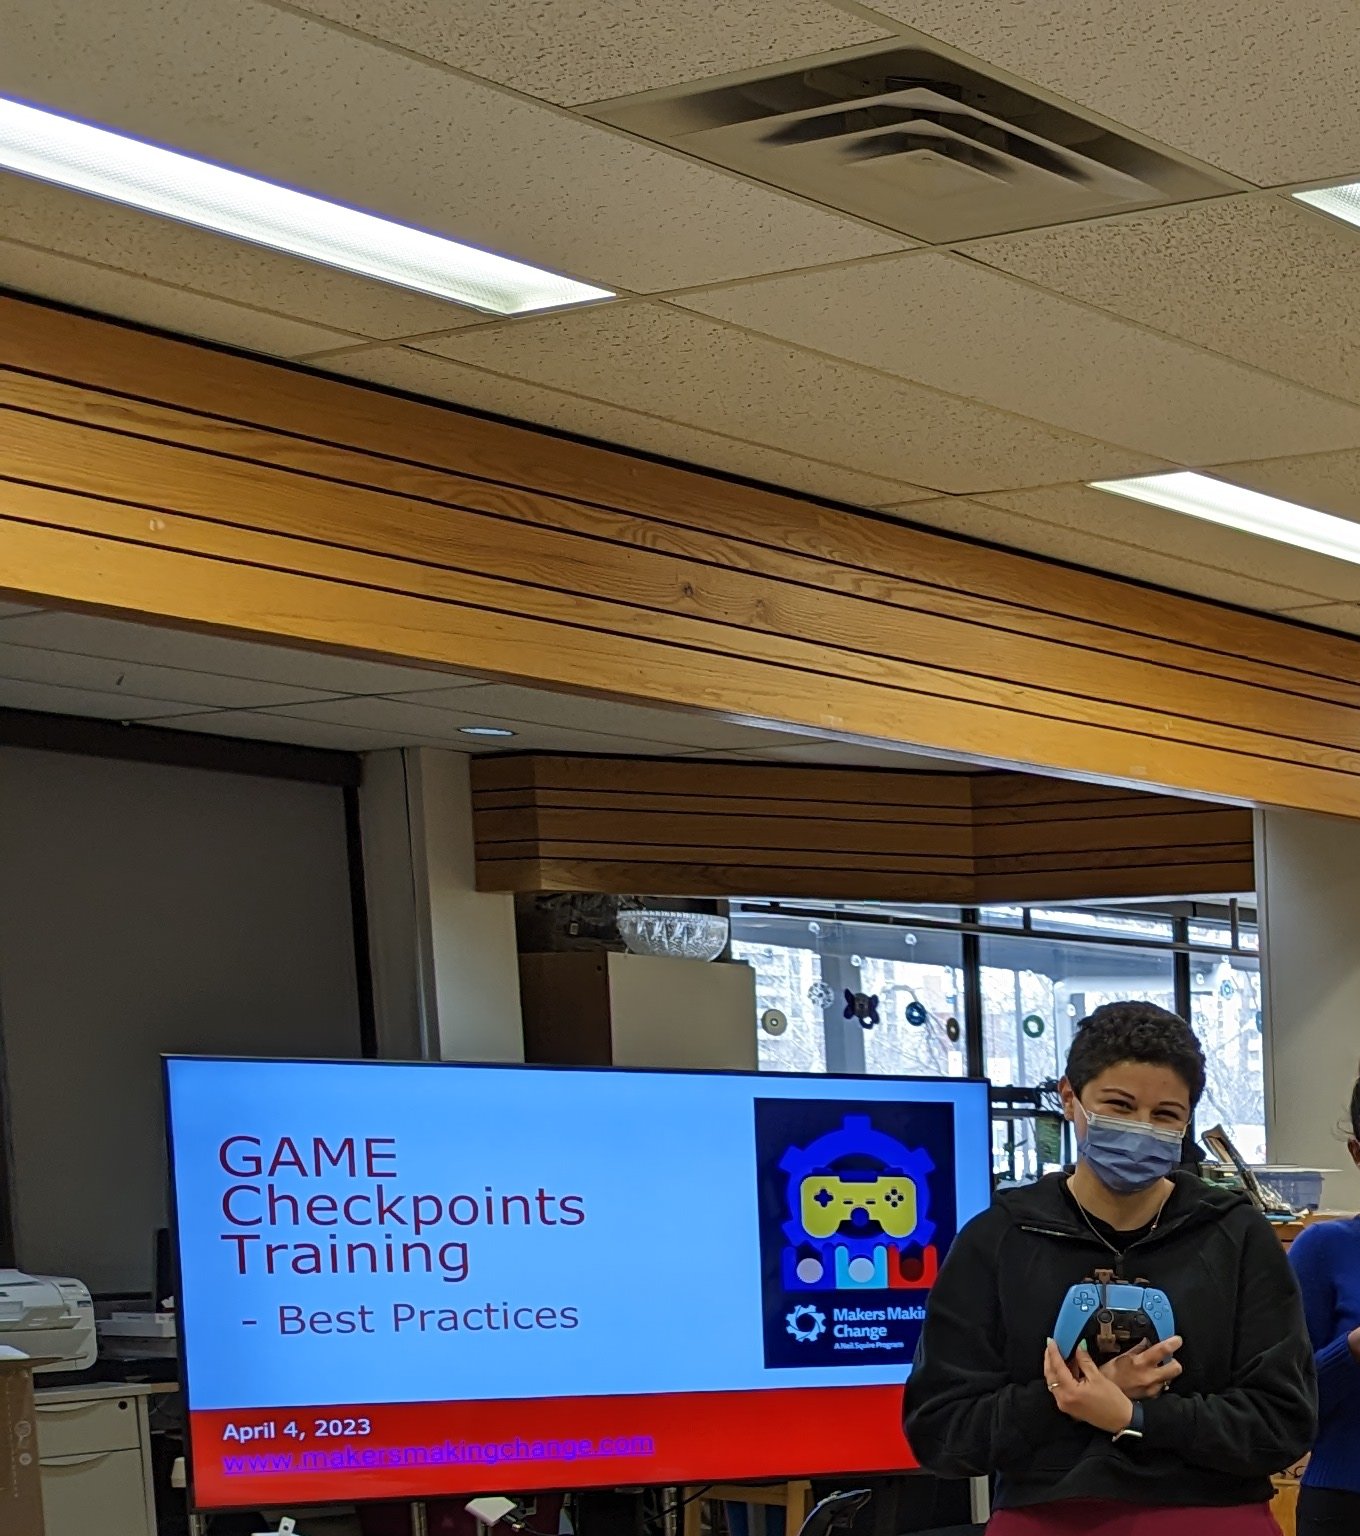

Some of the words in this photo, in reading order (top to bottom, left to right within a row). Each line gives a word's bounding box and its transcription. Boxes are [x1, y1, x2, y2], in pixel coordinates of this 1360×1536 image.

[218, 1134, 398, 1179] GAME
[220, 1182, 587, 1233] Checkpoints
[220, 1233, 470, 1283] Training
[278, 1303, 375, 1336] Best
[392, 1301, 580, 1334] Practices
[833, 1307, 886, 1321] Makers
[833, 1324, 887, 1340] Change
[875, 1341, 904, 1350] Program
[223, 1421, 276, 1444] April
[283, 1421, 306, 1441] 4,
[314, 1418, 371, 1437] 2023
[222, 1436, 654, 1475] www.makersmakingchange.com
